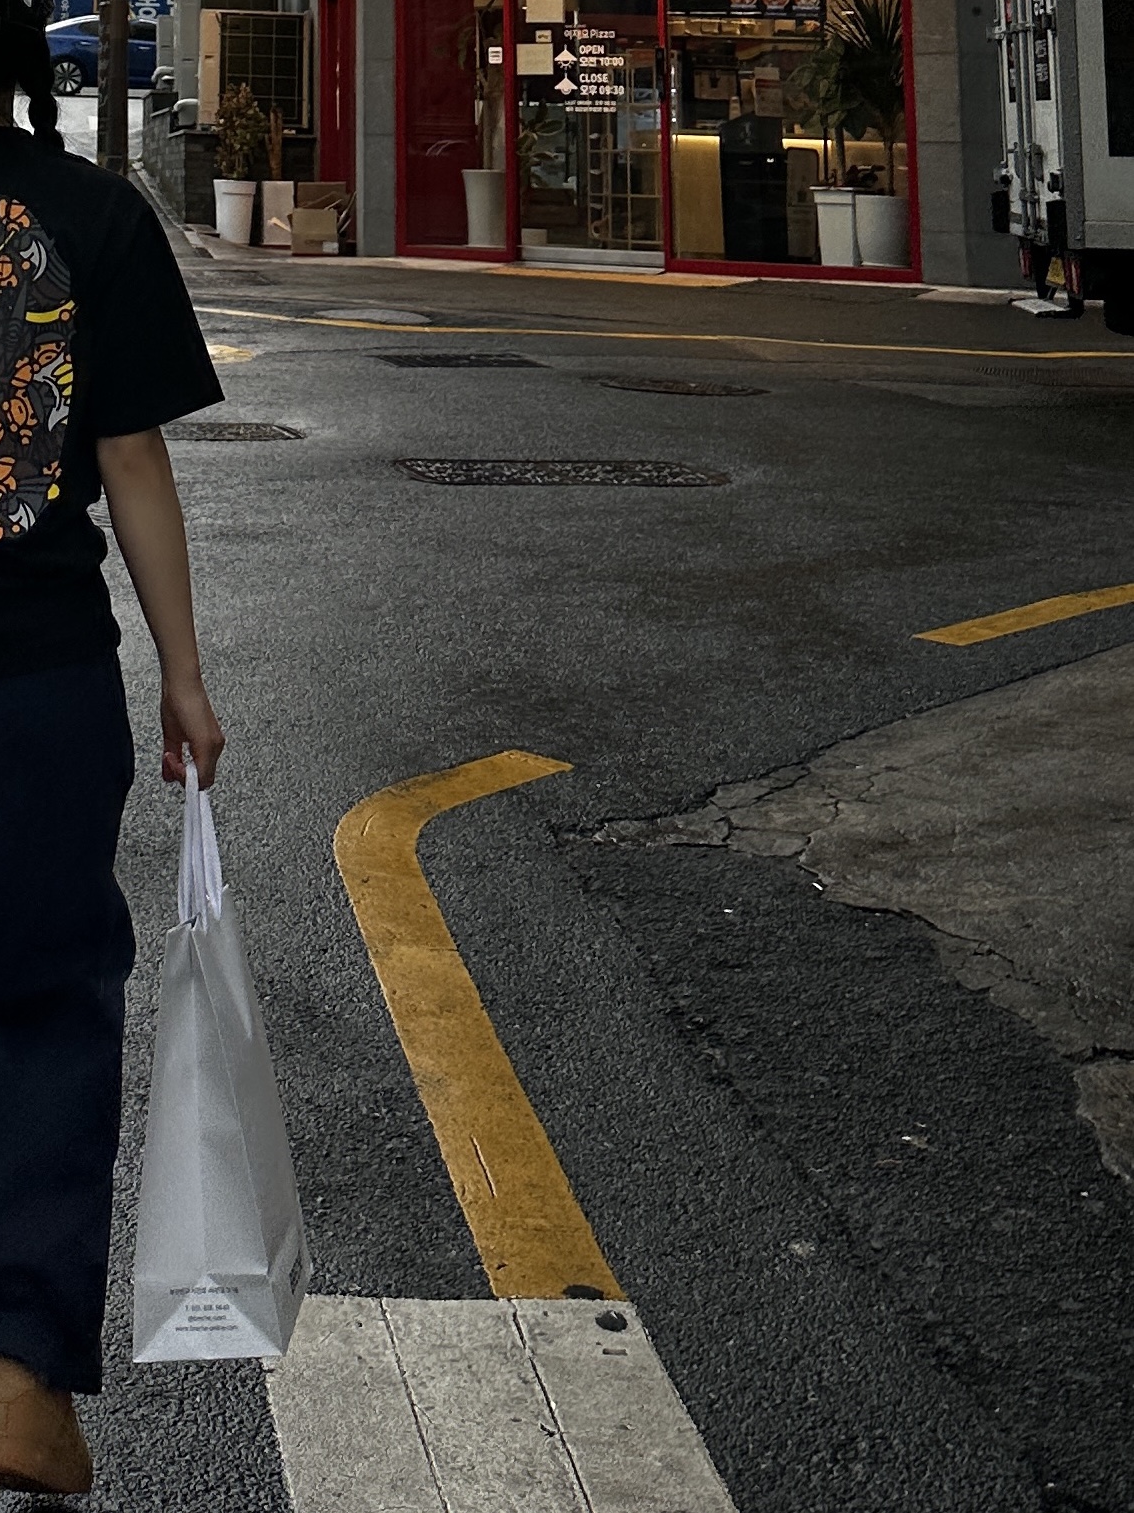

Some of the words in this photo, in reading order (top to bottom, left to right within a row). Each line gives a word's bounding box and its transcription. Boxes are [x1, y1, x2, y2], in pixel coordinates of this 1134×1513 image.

[579, 45, 605, 55] OPEN
[598, 56, 624, 67] 10:00
[579, 73, 609, 84] CLOSE
